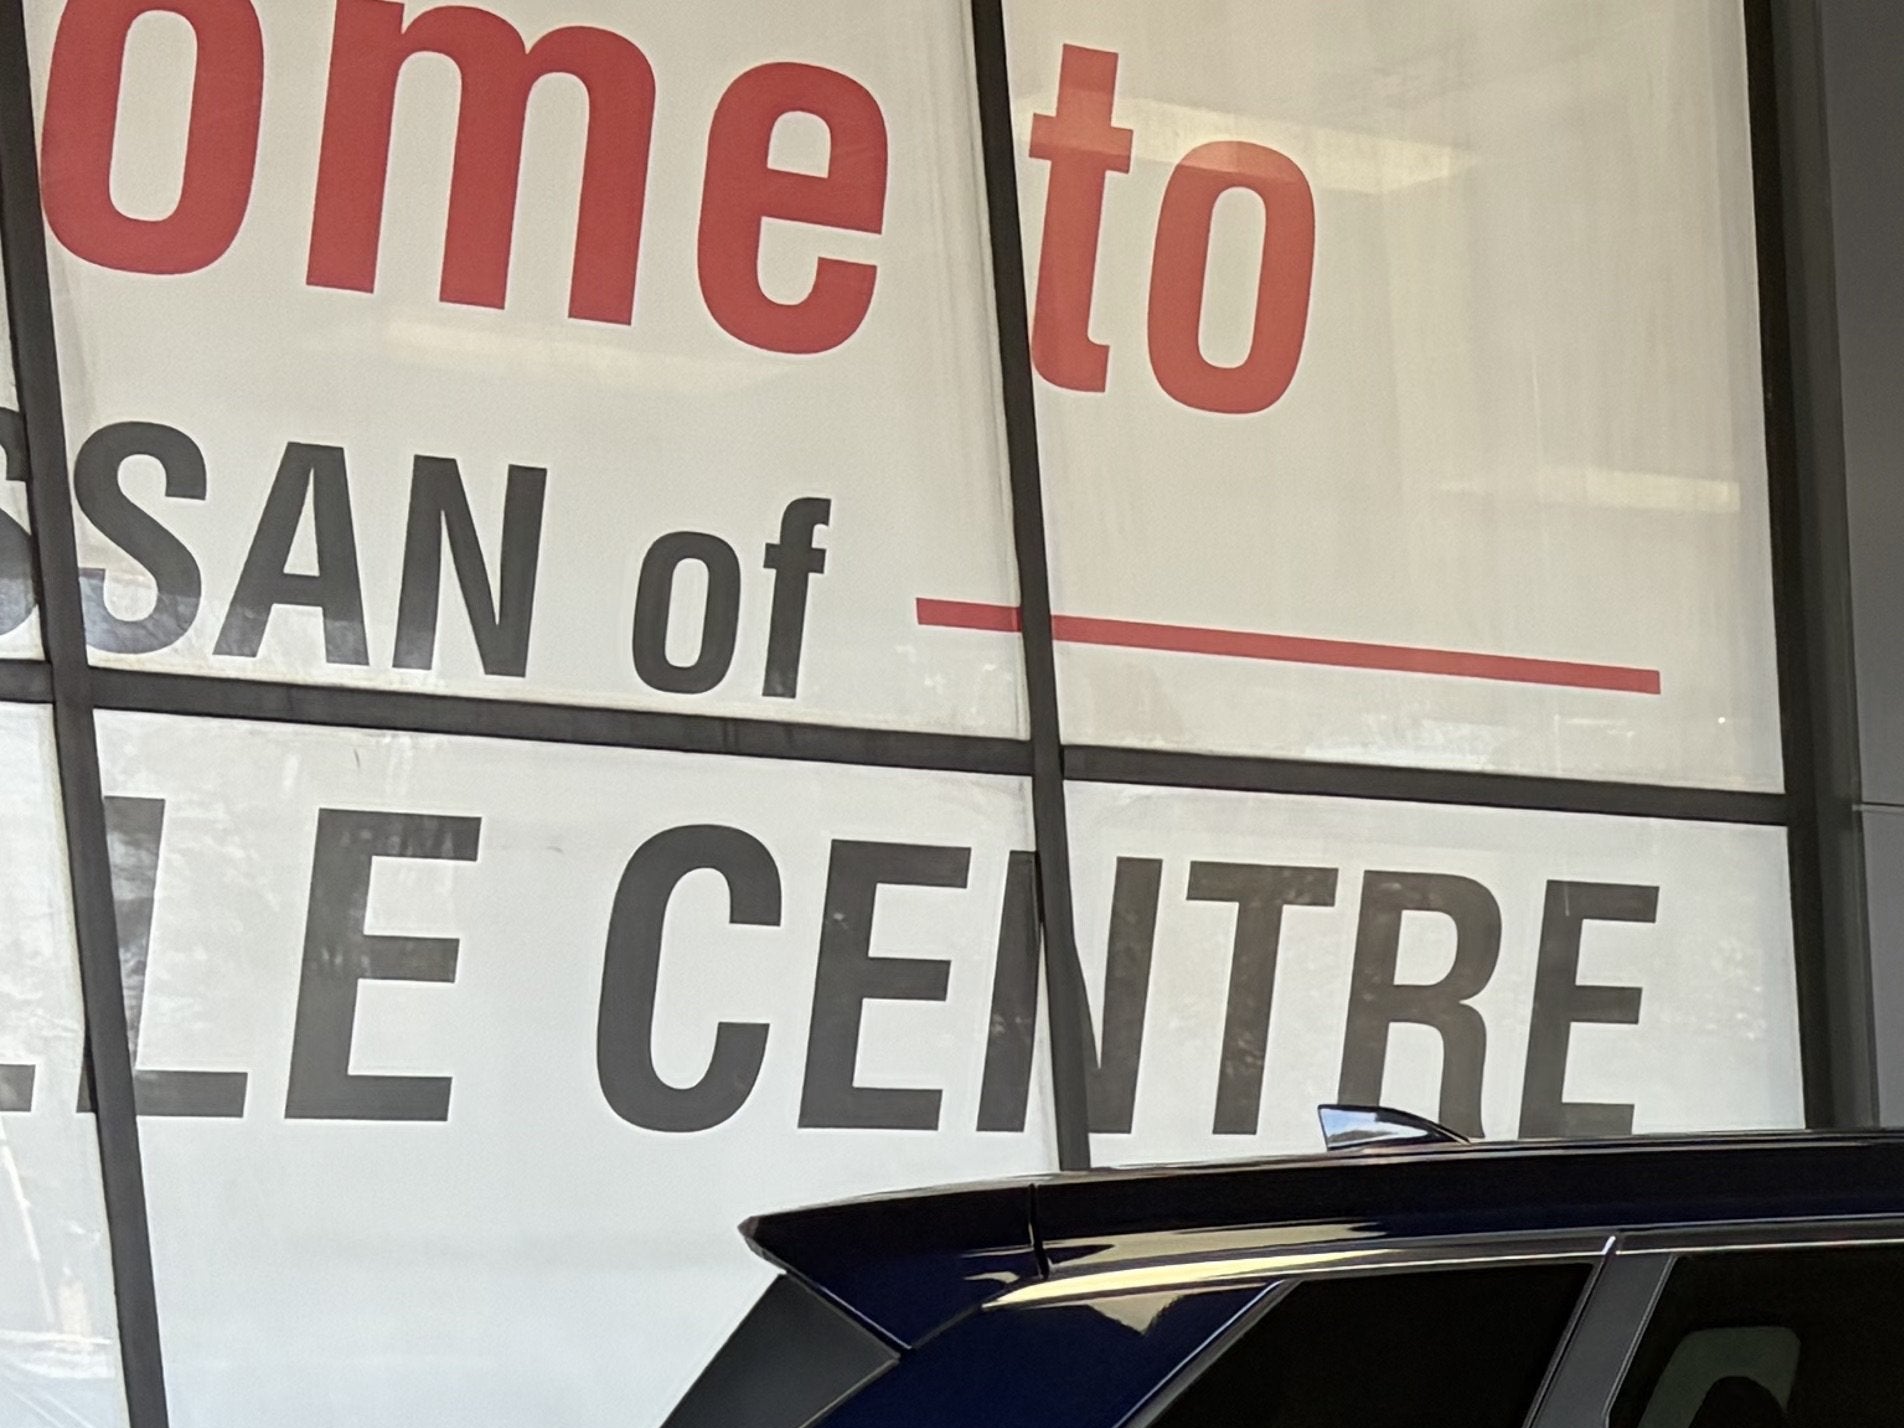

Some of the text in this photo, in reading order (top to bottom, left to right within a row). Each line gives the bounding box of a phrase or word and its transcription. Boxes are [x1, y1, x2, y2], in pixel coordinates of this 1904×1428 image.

[40, 0, 1317, 415] ome to
[0, 410, 833, 698] SAN of
[594, 823, 1660, 1139] CENTRE
